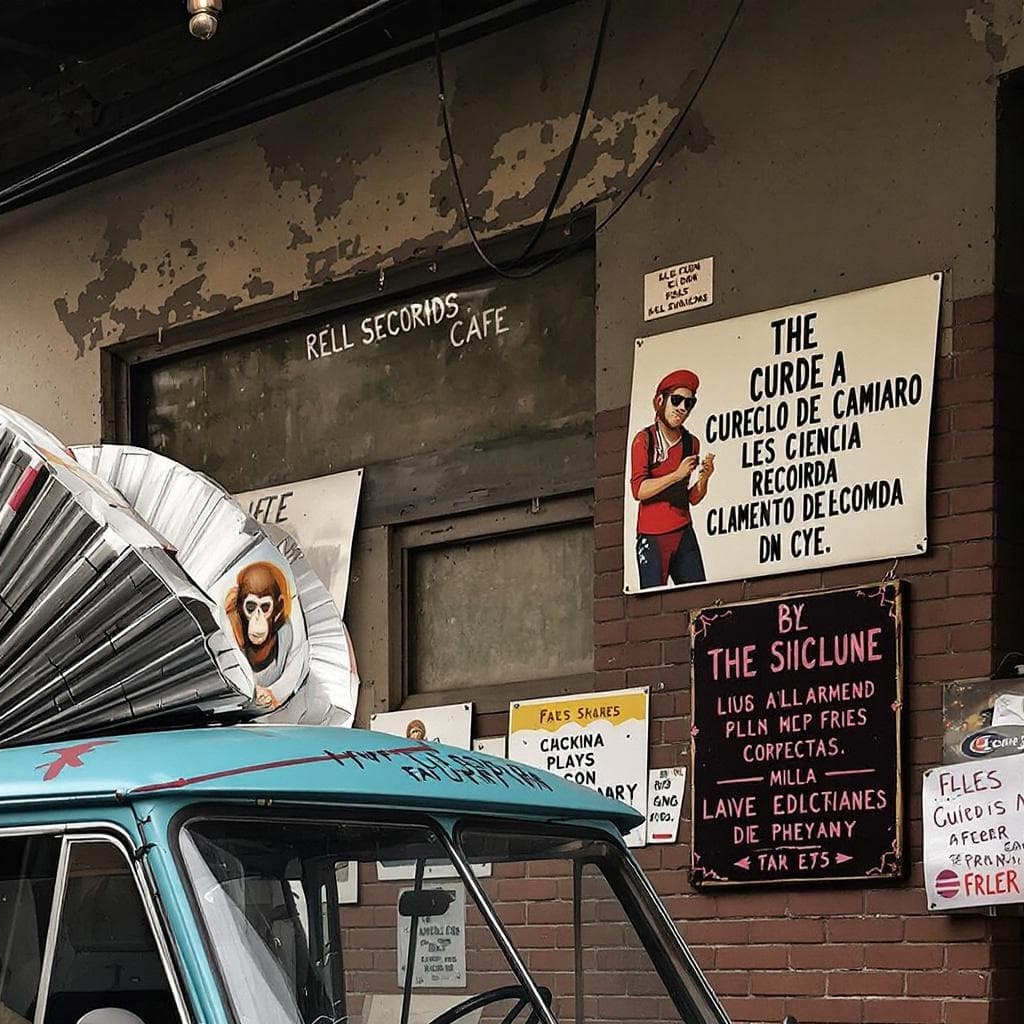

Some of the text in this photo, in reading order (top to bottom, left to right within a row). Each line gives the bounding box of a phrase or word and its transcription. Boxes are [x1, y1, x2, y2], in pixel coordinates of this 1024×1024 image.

[450, 306, 509, 347] CAFE
[771, 312, 818, 355] THE
[750, 351, 847, 402] CURDE A
[705, 373, 922, 443] CURECLO DE CAMIARO
[741, 422, 861, 468] LES CIENCIA
[706, 497, 794, 536] CLAMENTO
[778, 604, 808, 633] BY
[708, 645, 757, 681] THE
[820, 708, 867, 730] FRIES
[547, 753, 595, 770] PLAYS
[769, 768, 817, 786] MILLA
[734, 820, 856, 844] DIE PHEYANY
[964, 869, 1020, 896] FRLER
